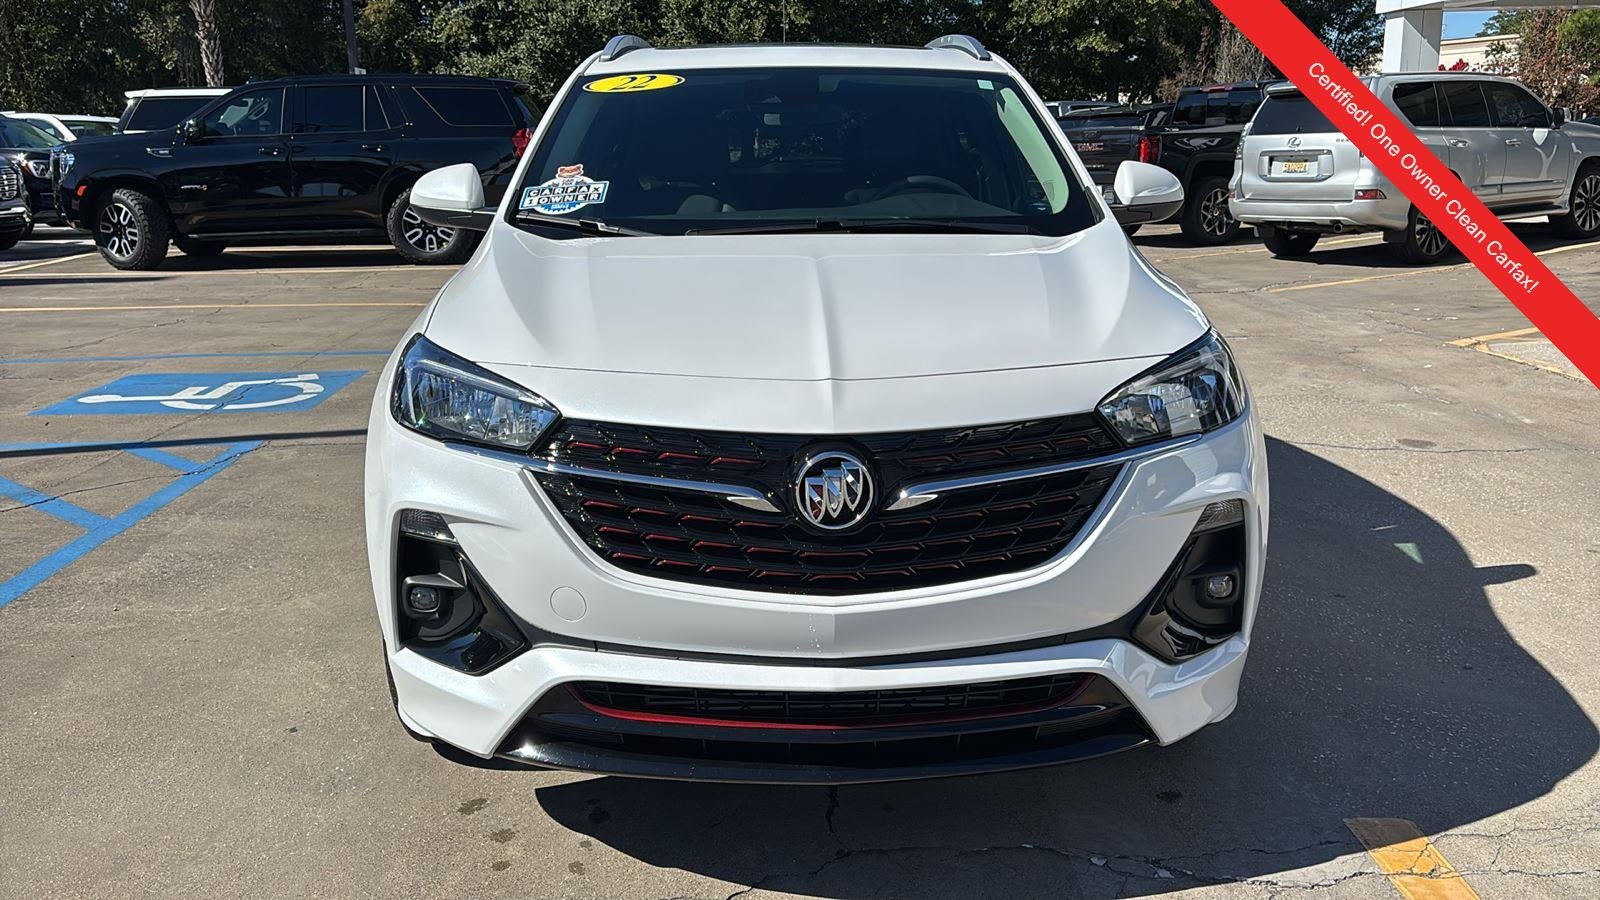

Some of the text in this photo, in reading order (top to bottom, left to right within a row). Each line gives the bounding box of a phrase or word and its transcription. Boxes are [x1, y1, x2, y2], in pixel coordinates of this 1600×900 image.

[608, 75, 657, 91] 22
[529, 186, 601, 197] CARFAX
[538, 193, 599, 204] OWNER
